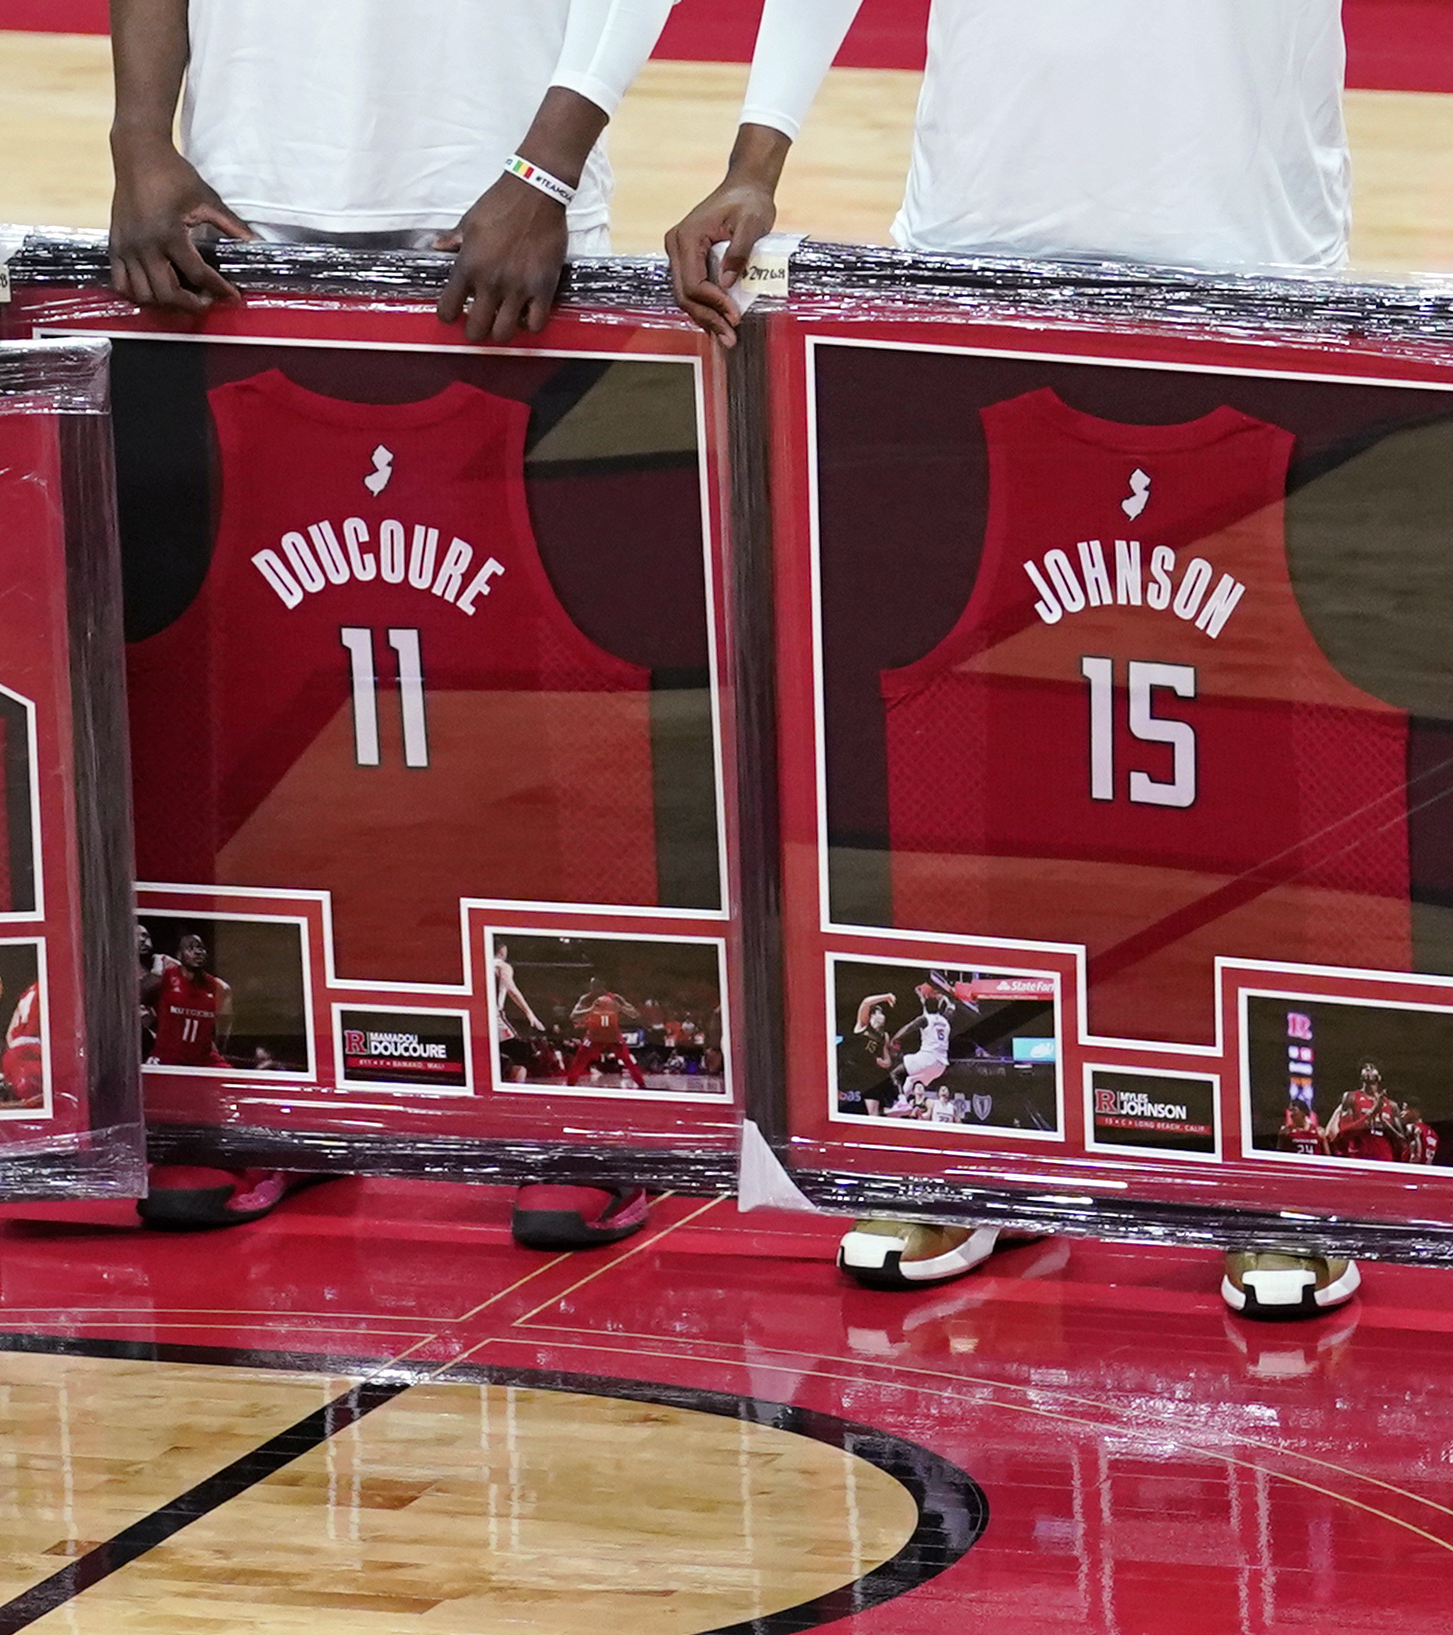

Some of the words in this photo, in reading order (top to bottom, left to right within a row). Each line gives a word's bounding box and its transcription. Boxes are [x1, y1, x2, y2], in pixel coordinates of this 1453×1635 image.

[250, 515, 506, 617] DOUCOURE
[1022, 539, 1247, 641] JOHNSON
[339, 626, 430, 769] 11
[1080, 654, 1198, 809] 15
[344, 1030, 368, 1055] R
[370, 1032, 418, 1043] MAMADOU
[371, 1042, 447, 1058] DOUCOURE
[1095, 1088, 1118, 1114] R
[1120, 1091, 1148, 1103] MYLES
[1120, 1102, 1187, 1120] JOHNSON
